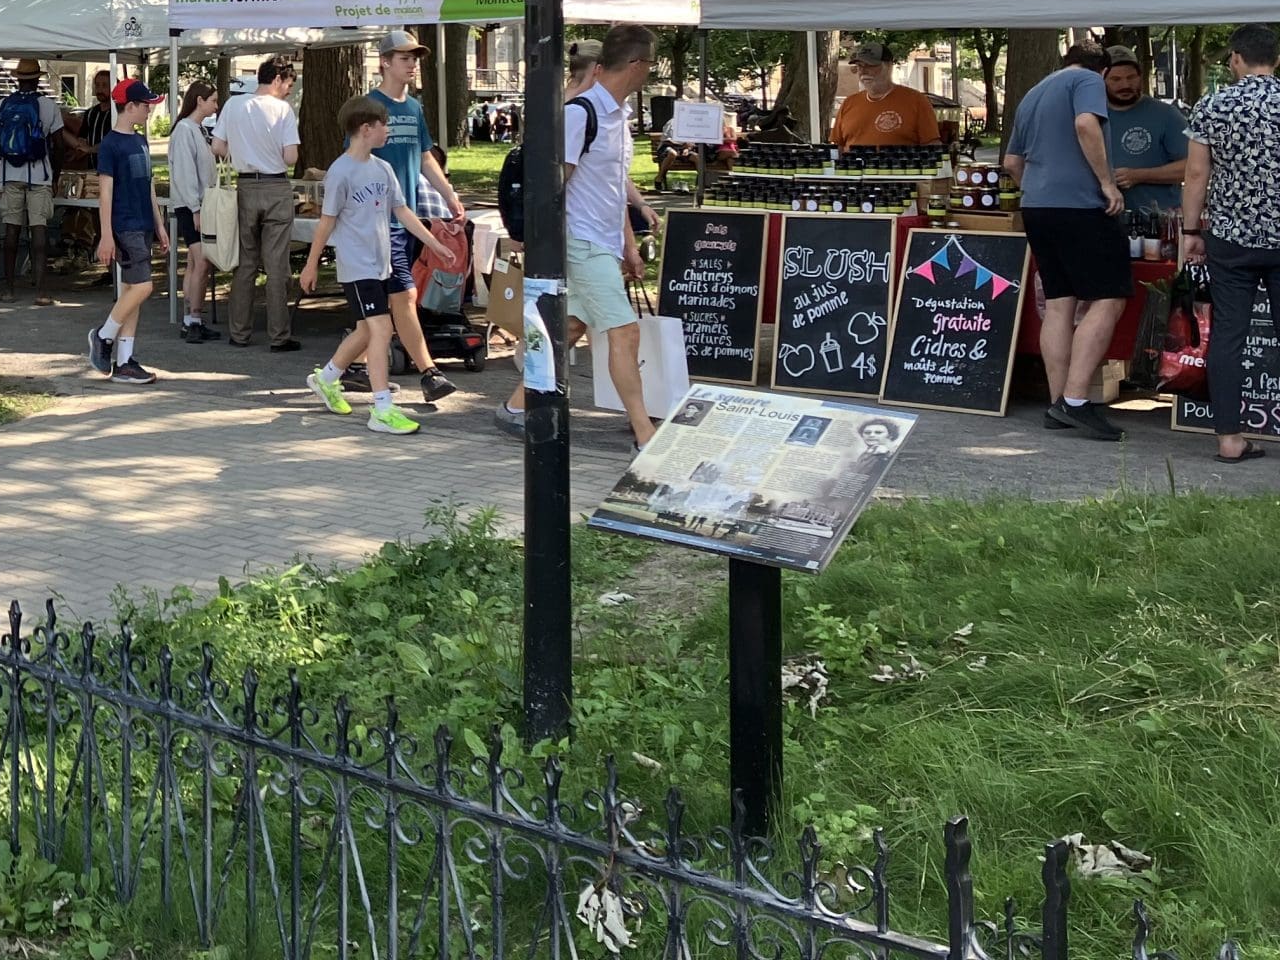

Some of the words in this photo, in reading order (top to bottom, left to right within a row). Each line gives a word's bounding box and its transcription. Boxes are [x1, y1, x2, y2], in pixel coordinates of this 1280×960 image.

[335, 5, 370, 19] Projet
[376, 3, 391, 14] de
[783, 246, 891, 283] SLUSH
[683, 269, 734, 284] Chutneys
[669, 279, 709, 293] Confits
[712, 282, 758, 297] d'oignons
[793, 290, 811, 310] au
[811, 281, 838, 302] jus
[678, 295, 736, 310] Marinades
[792, 313, 806, 329] de
[807, 291, 849, 324] pomme
[912, 297, 985, 312] Dégustation
[682, 321, 729, 336] aramels
[932, 313, 991, 335] gratuite
[684, 333, 732, 347] nfitures
[910, 334, 967, 359] Cidres
[969, 339, 988, 360] &
[701, 346, 713, 356] de
[714, 346, 754, 361] pommes
[851, 352, 877, 380] 4$
[939, 360, 955, 374] de
[690, 388, 710, 399] Le
[714, 391, 771, 407] square
[716, 401, 801, 422] Saint-Louis
